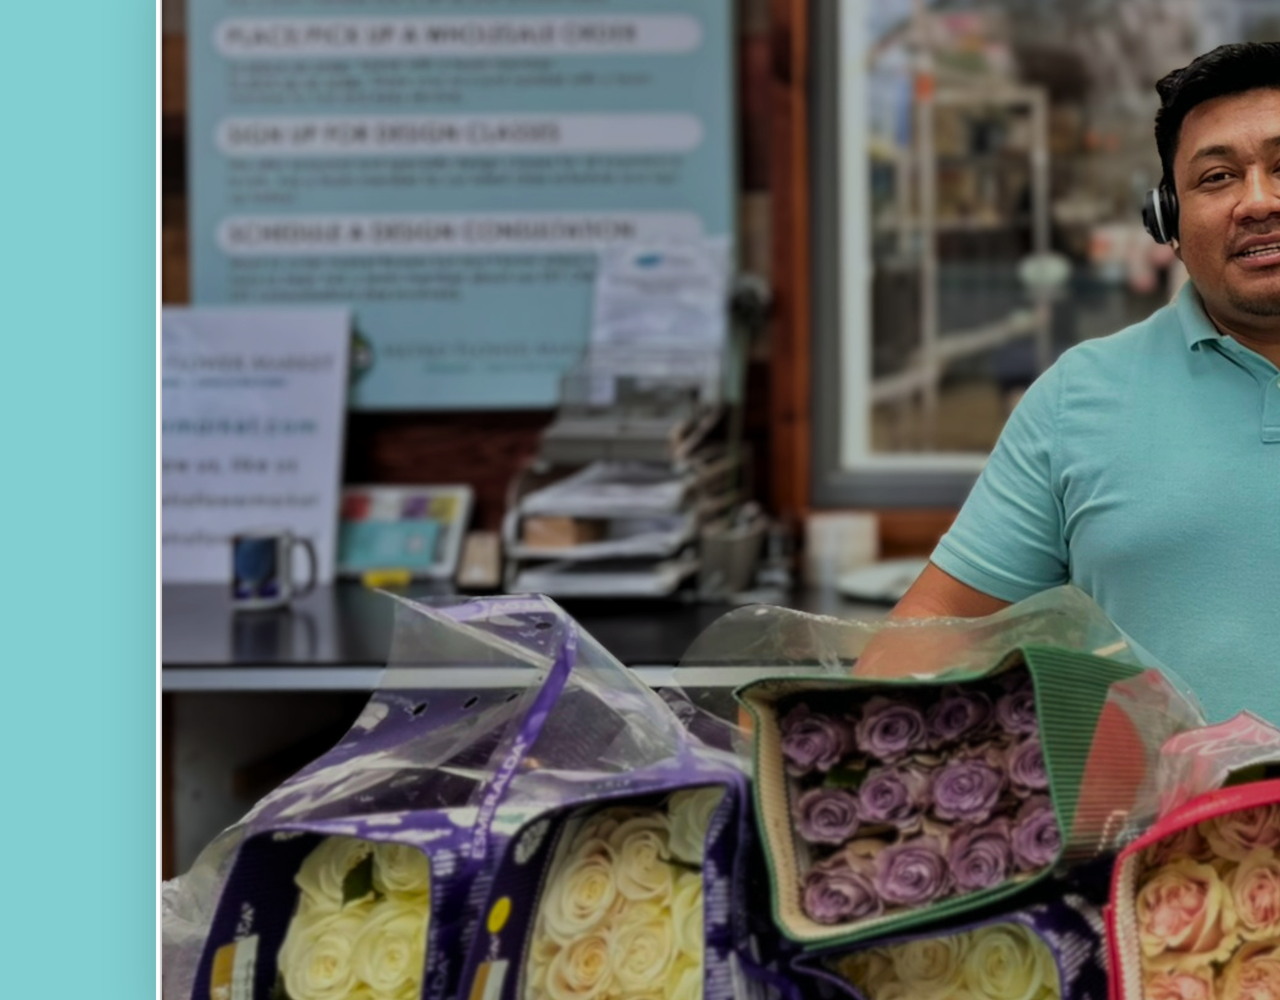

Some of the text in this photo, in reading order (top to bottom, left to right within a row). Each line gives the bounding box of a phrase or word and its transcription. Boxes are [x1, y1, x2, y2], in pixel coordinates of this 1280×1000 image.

[402, 26, 418, 43] A
[425, 25, 555, 44] WHOLESALE
[561, 24, 638, 43] ORDER
[227, 123, 562, 144] SIGN UP FOR DESIGN CLASSES
[227, 221, 637, 242] SCHEDULE A DESIGN CONSULTATION
